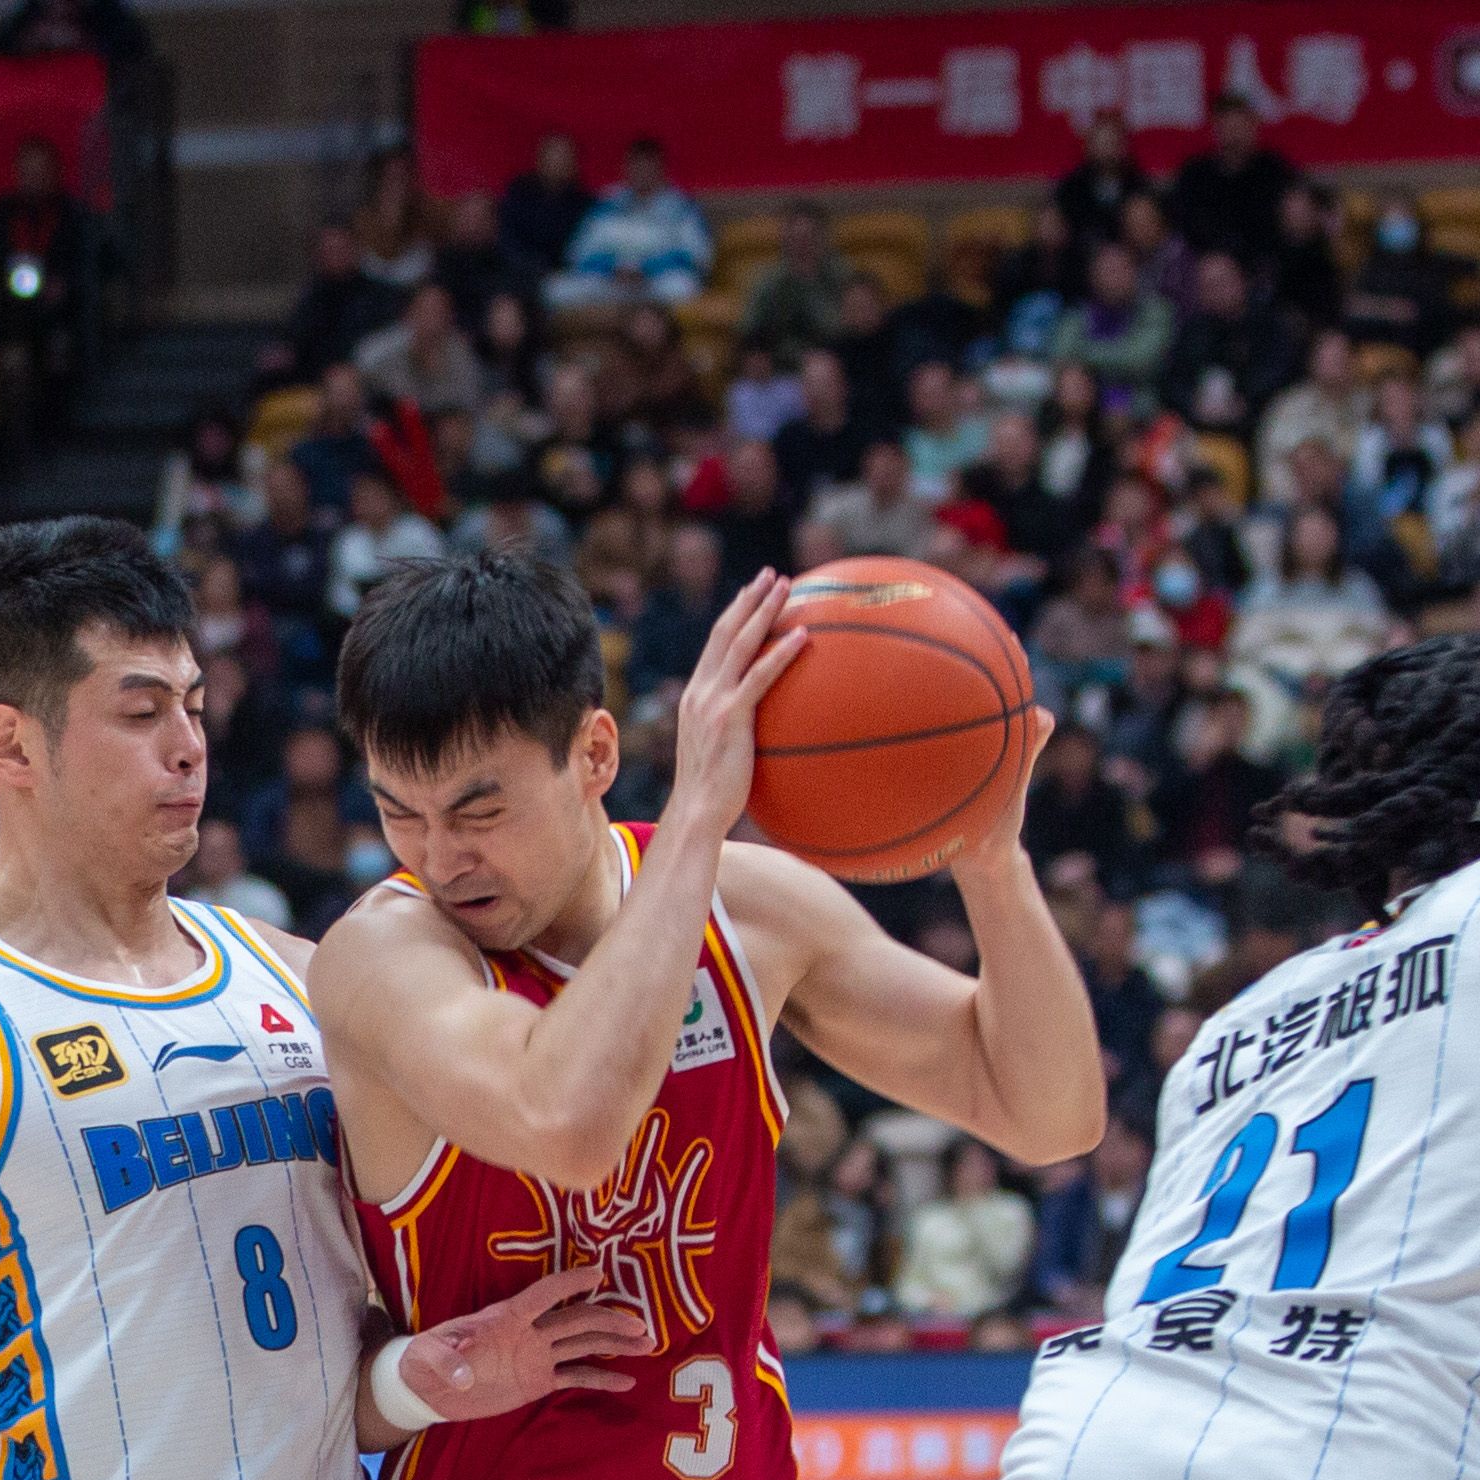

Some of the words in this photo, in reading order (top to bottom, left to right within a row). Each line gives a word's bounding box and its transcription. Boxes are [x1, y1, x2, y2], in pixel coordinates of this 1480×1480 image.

[284, 1056, 313, 1069] CGB
[1132, 1077, 1376, 1306] 21
[234, 1224, 298, 1352] 8
